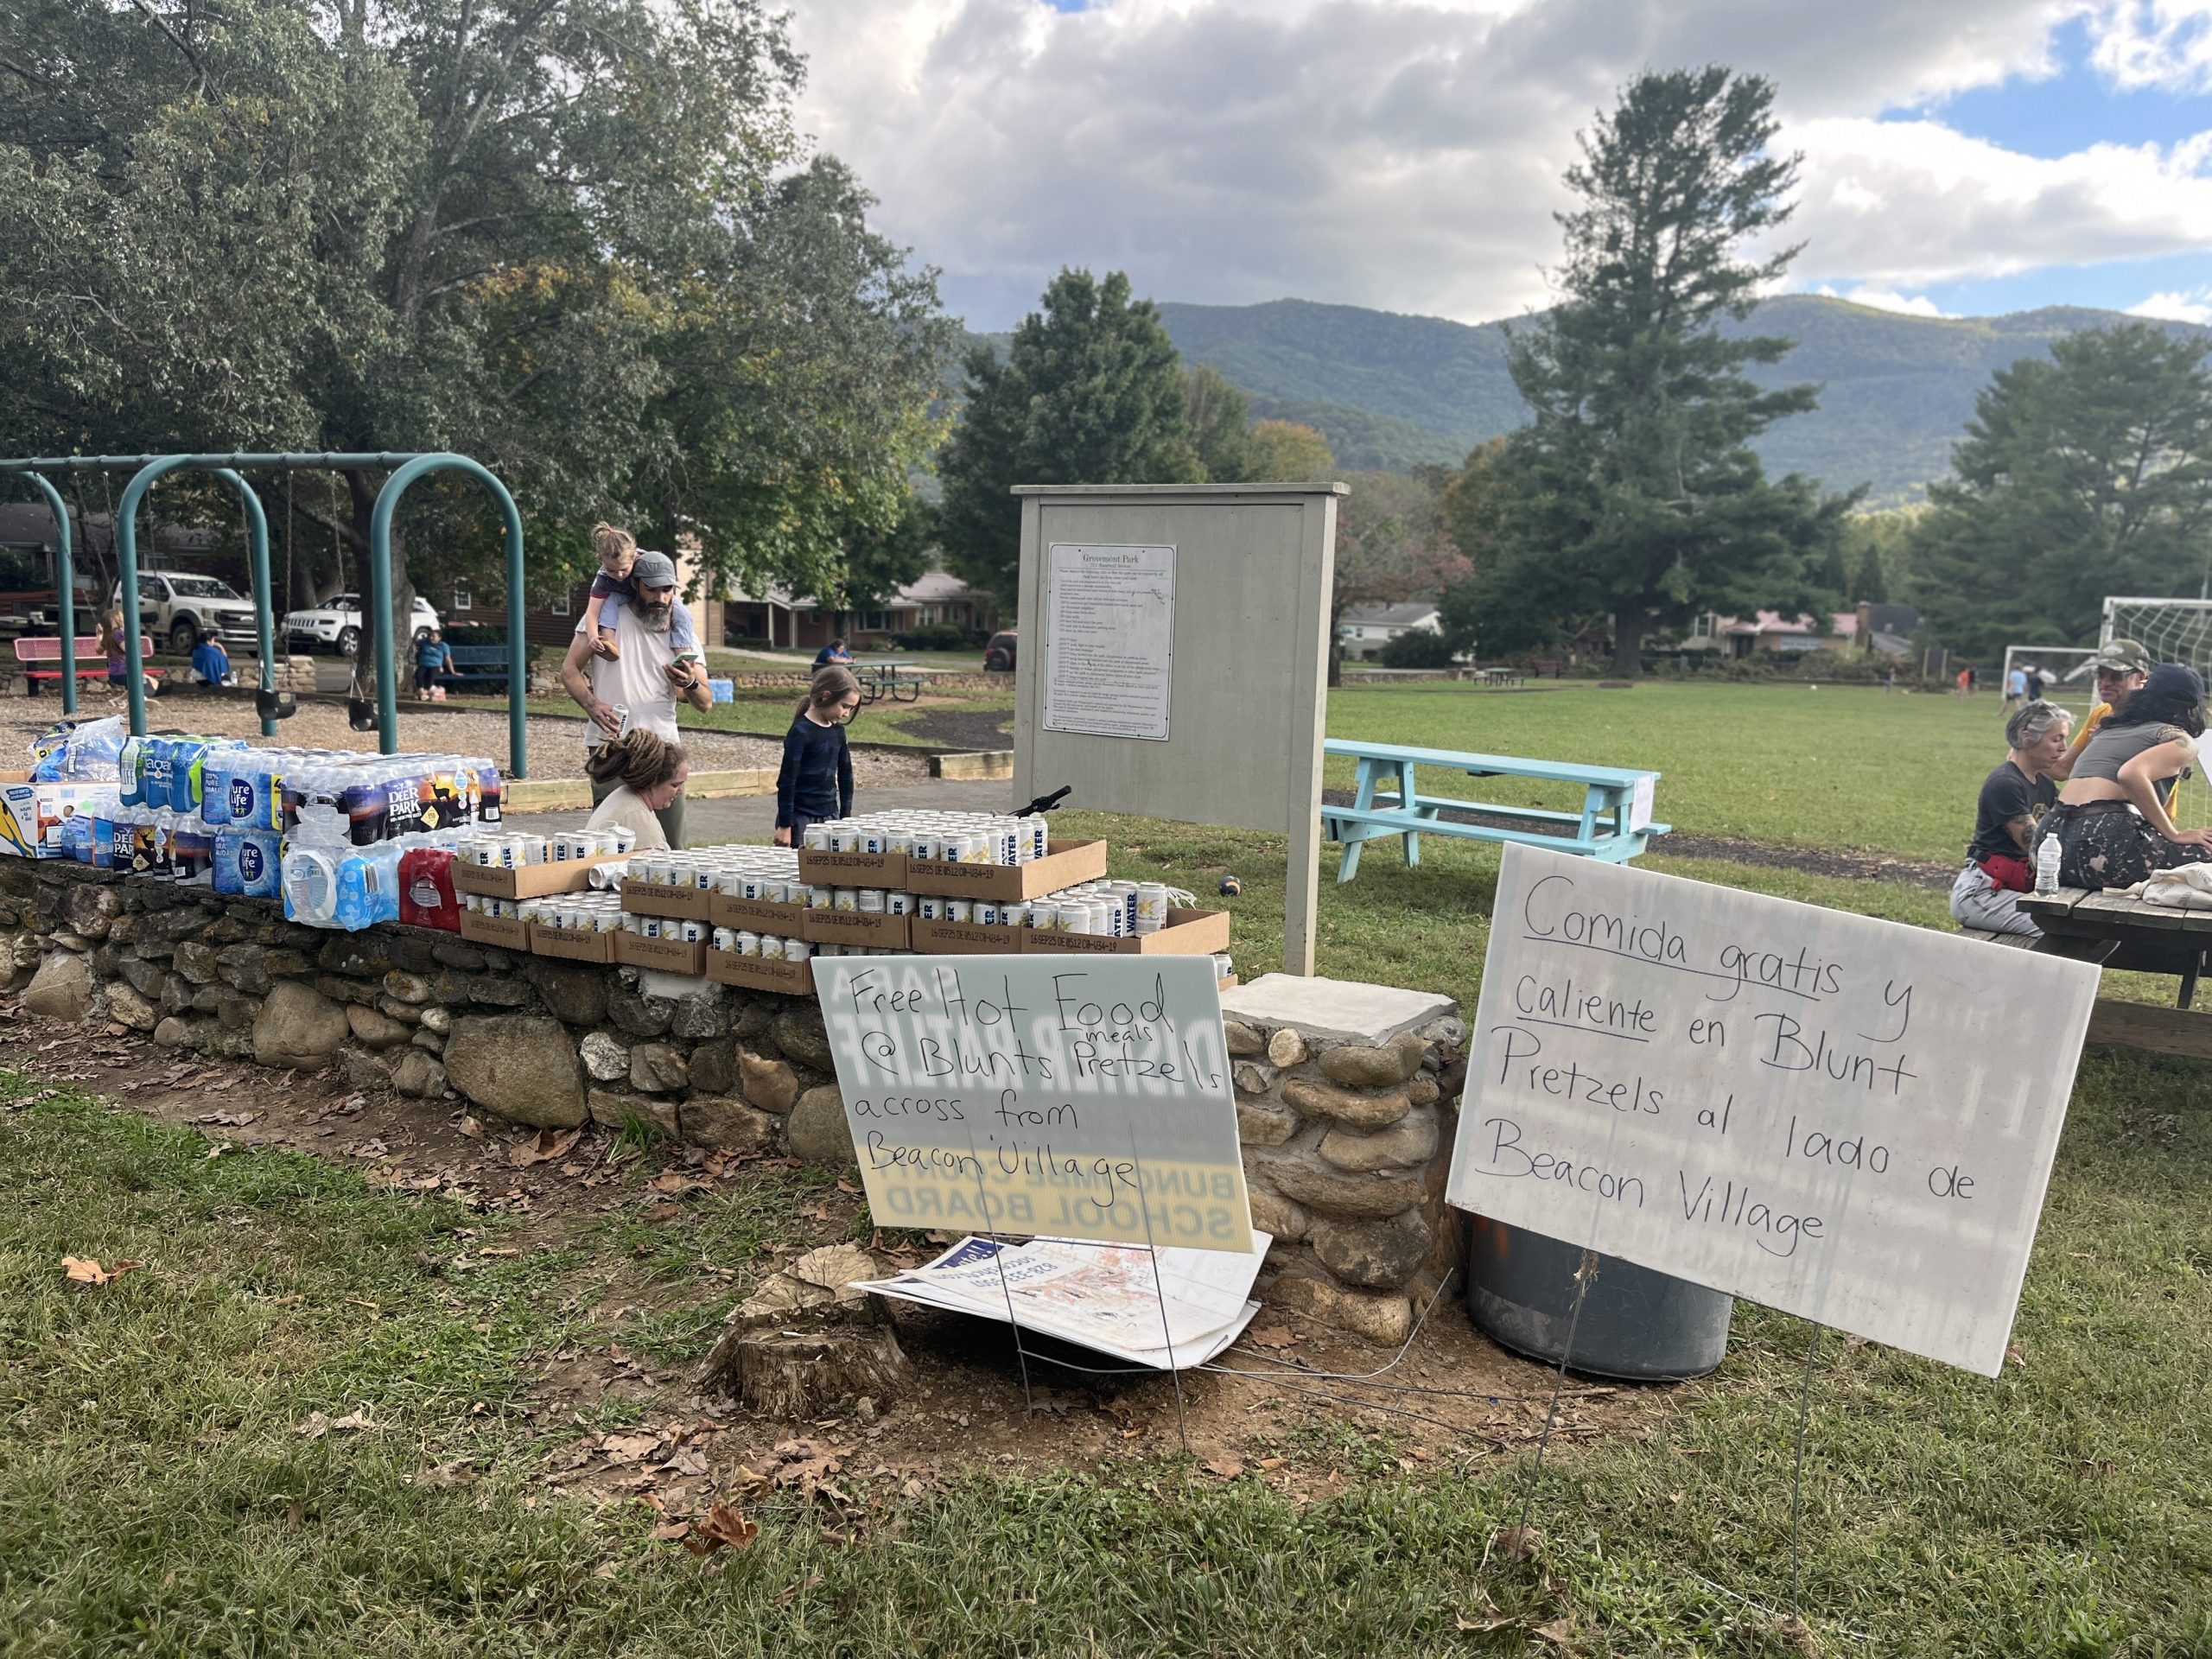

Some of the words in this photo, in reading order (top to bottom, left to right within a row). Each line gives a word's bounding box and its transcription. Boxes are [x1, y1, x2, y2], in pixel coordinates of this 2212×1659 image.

[1083, 554, 1121, 563] Grovemont
[1123, 555, 1140, 564] Park
[388, 787, 420, 804] DEER
[389, 798, 422, 817] PARK
[114, 845, 134, 855] PAR
[1126, 893, 1135, 933] WATER
[1524, 875, 1687, 963] Comida
[1707, 946, 1844, 1001] gratis
[1858, 981, 1913, 1042] y
[849, 969, 922, 1014] Free
[937, 968, 1028, 1033] Hot
[1052, 973, 1173, 1033] Food
[1085, 1024, 1153, 1044] meals
[1689, 1018, 1726, 1047] en
[1755, 1013, 1917, 1095] Blunt
[861, 1031, 899, 1075] @
[920, 1038, 1052, 1079] Blunts
[1074, 1039, 1222, 1090] Pretzels
[855, 1096, 964, 1122] across
[995, 1089, 1078, 1128] from
[1491, 1026, 1663, 1115] Pretzels
[1697, 1094, 1733, 1135] al
[1785, 1115, 1890, 1174] lado
[1928, 1165, 1975, 1200] de
[867, 1130, 983, 1175] Beacon
[997, 1141, 1137, 1208] Village
[1475, 1118, 1643, 1208] Beacon
[1679, 1171, 1824, 1258] Village
